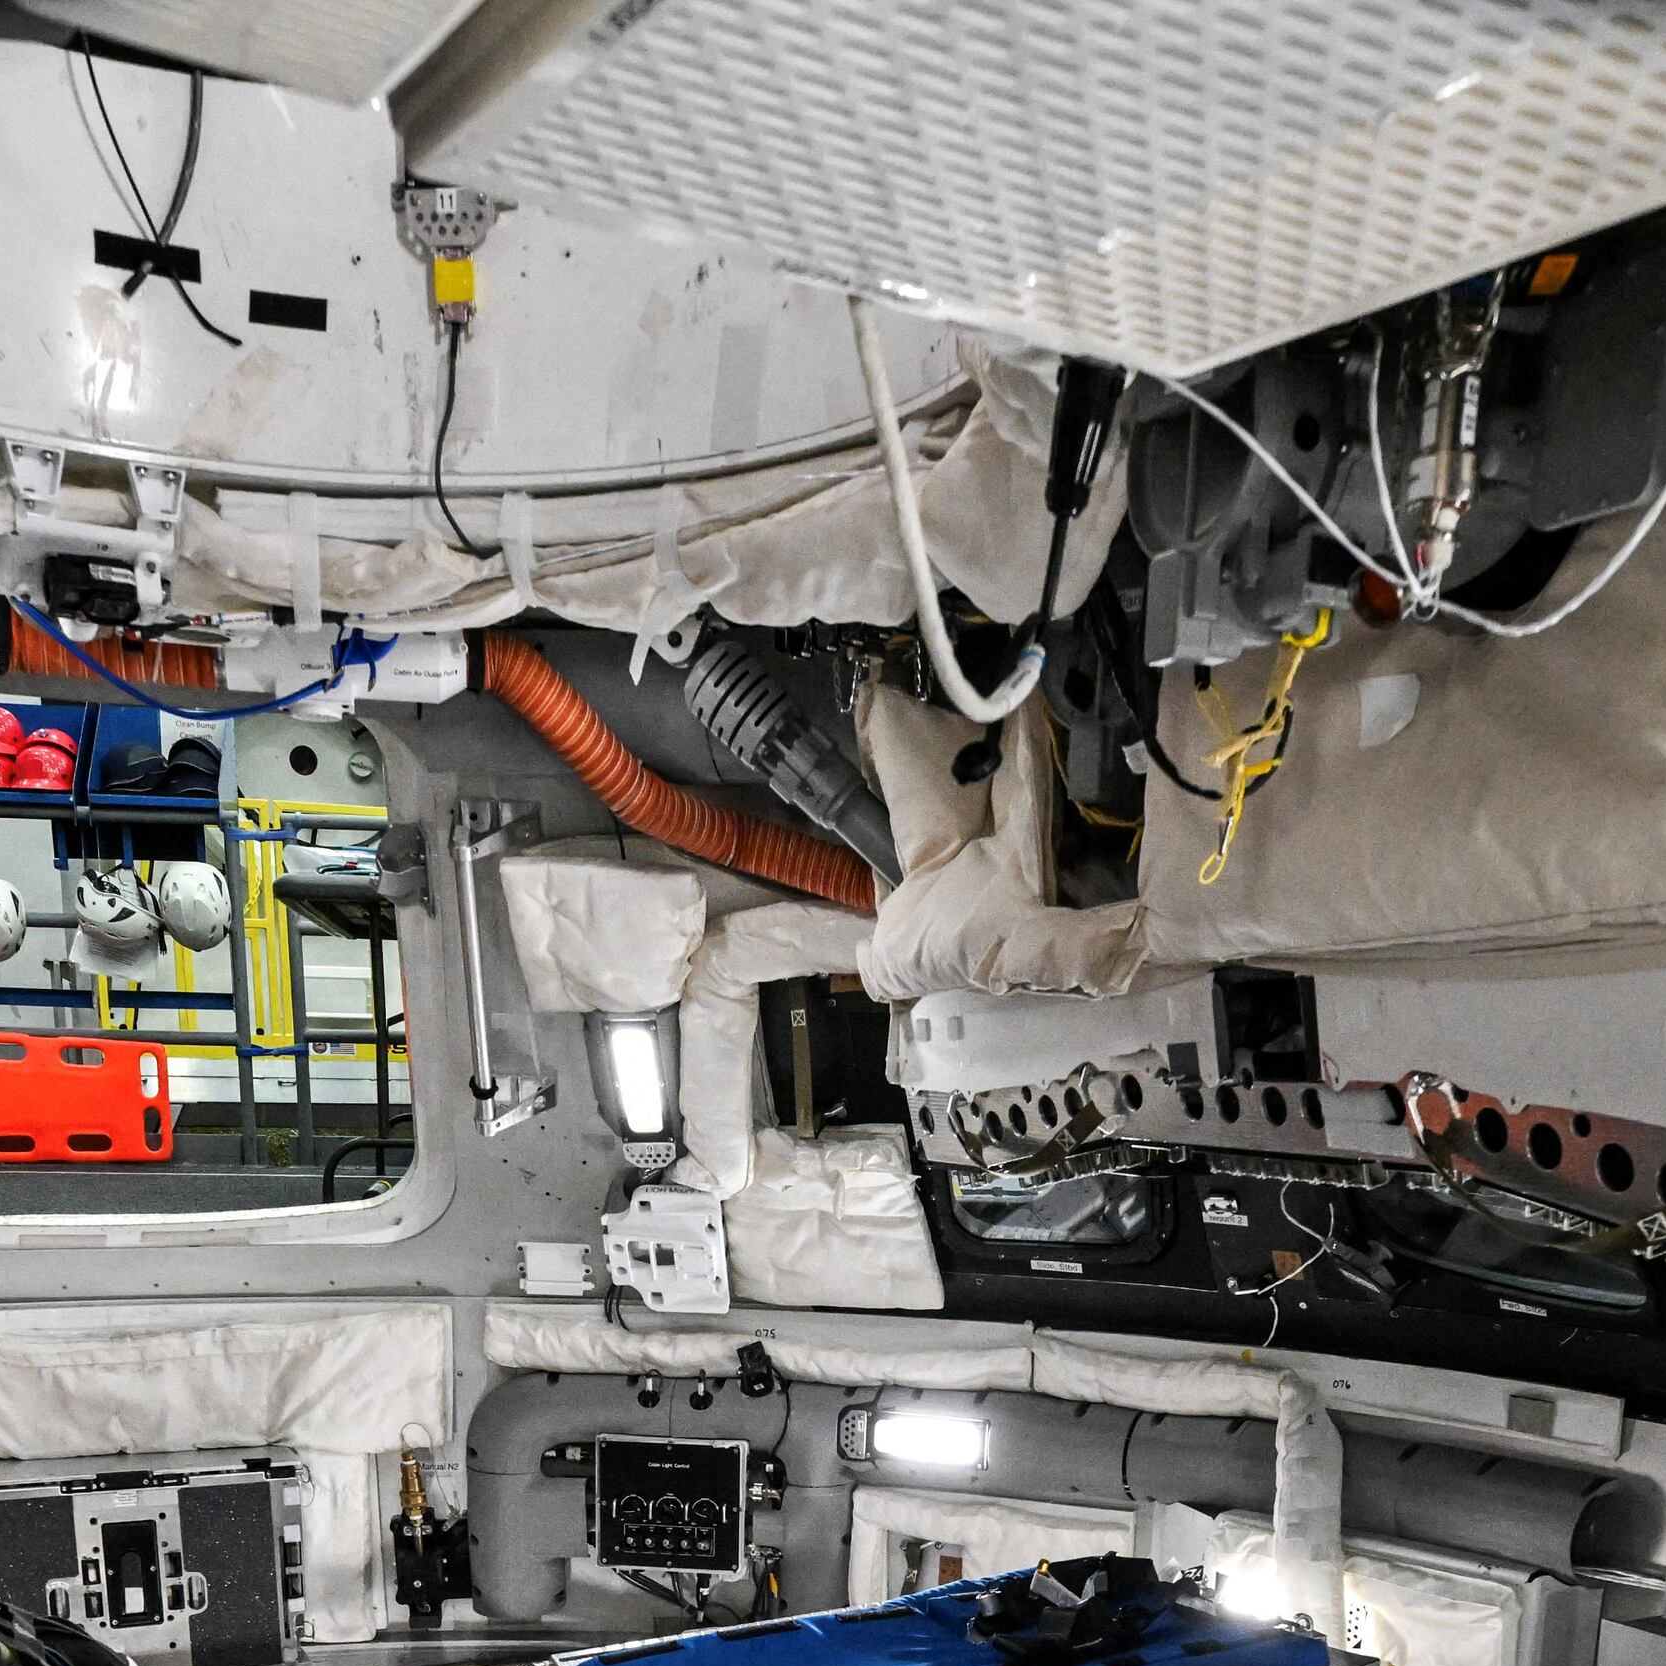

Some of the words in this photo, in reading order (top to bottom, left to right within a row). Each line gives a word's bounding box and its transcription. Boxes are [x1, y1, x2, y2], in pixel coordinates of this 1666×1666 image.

[439, 193, 453, 209] 11
[175, 720, 195, 728] Clean
[754, 1328, 777, 1340] 075
[1332, 1379, 1351, 1390] 076
